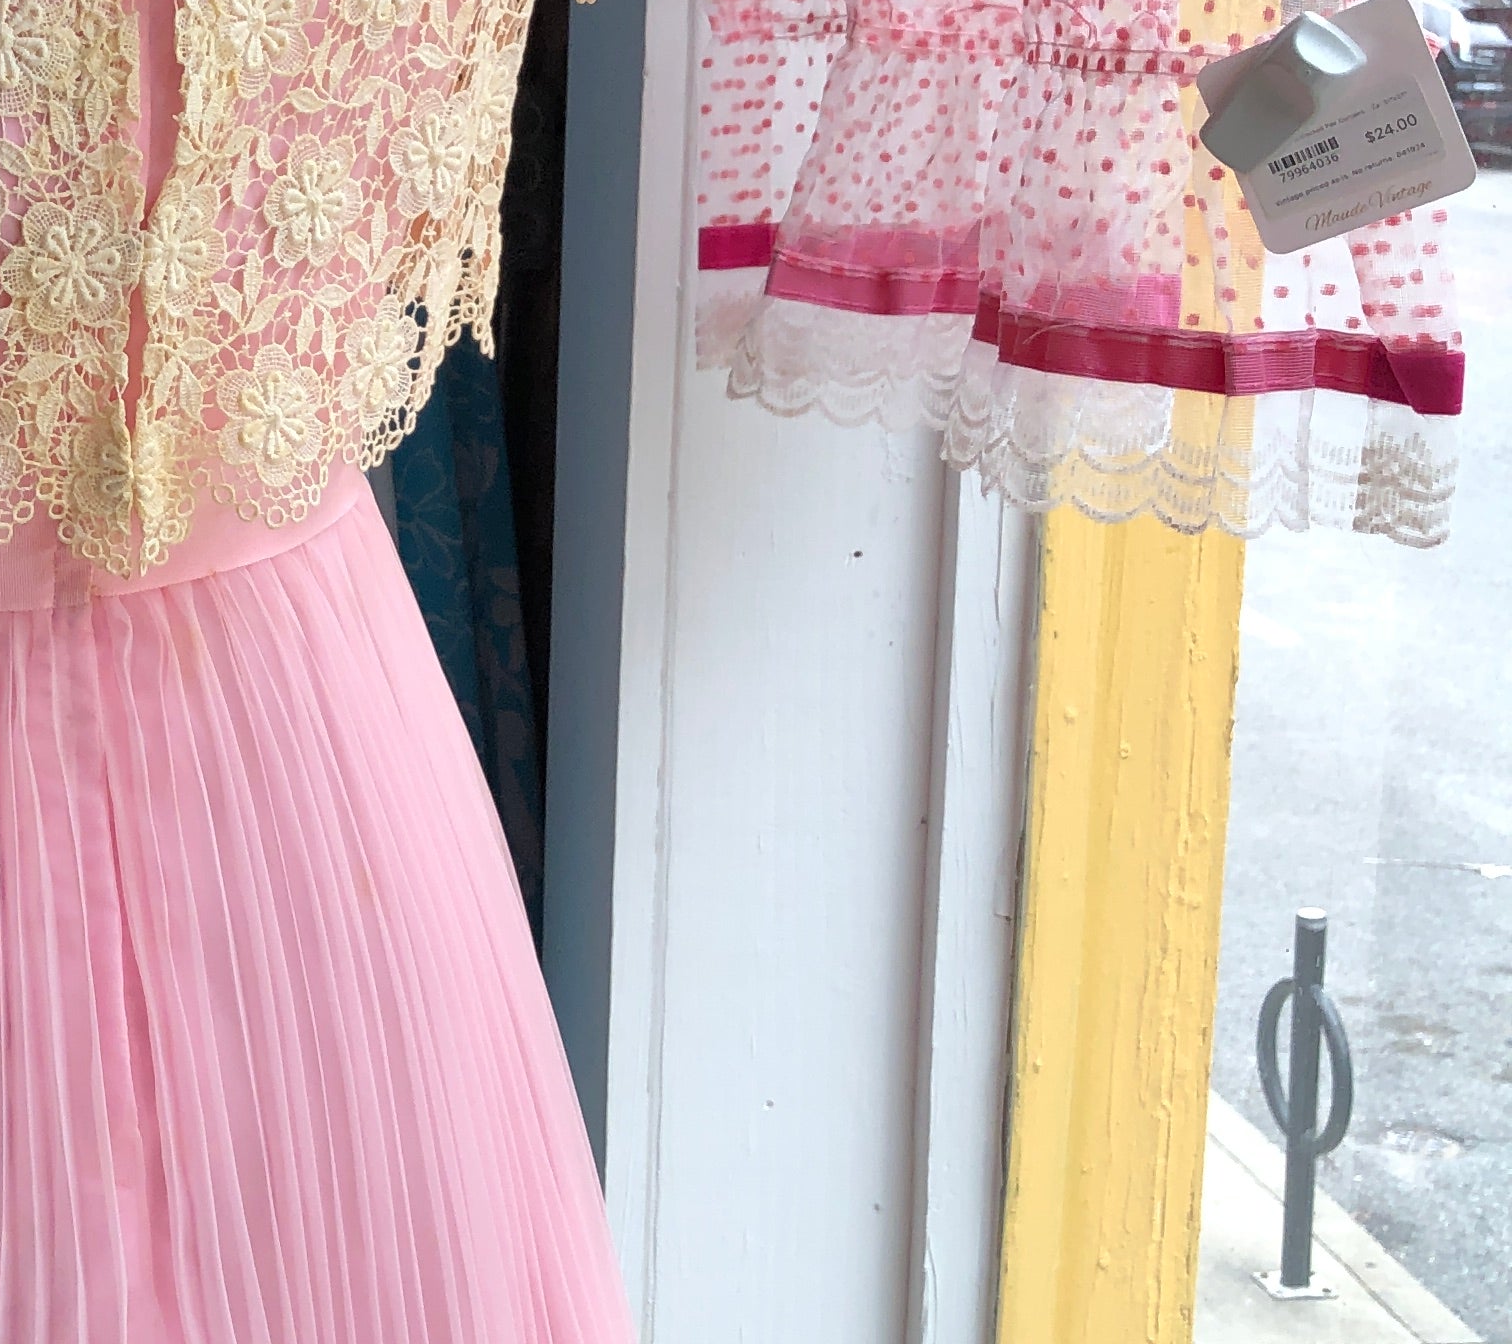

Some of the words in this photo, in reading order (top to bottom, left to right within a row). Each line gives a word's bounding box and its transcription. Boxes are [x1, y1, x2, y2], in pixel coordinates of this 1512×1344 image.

[1364, 113, 1418, 144] $24.00
[1279, 153, 1340, 184] 79964036
[1304, 202, 1367, 231] Maude
[1367, 179, 1433, 209] Vintage
